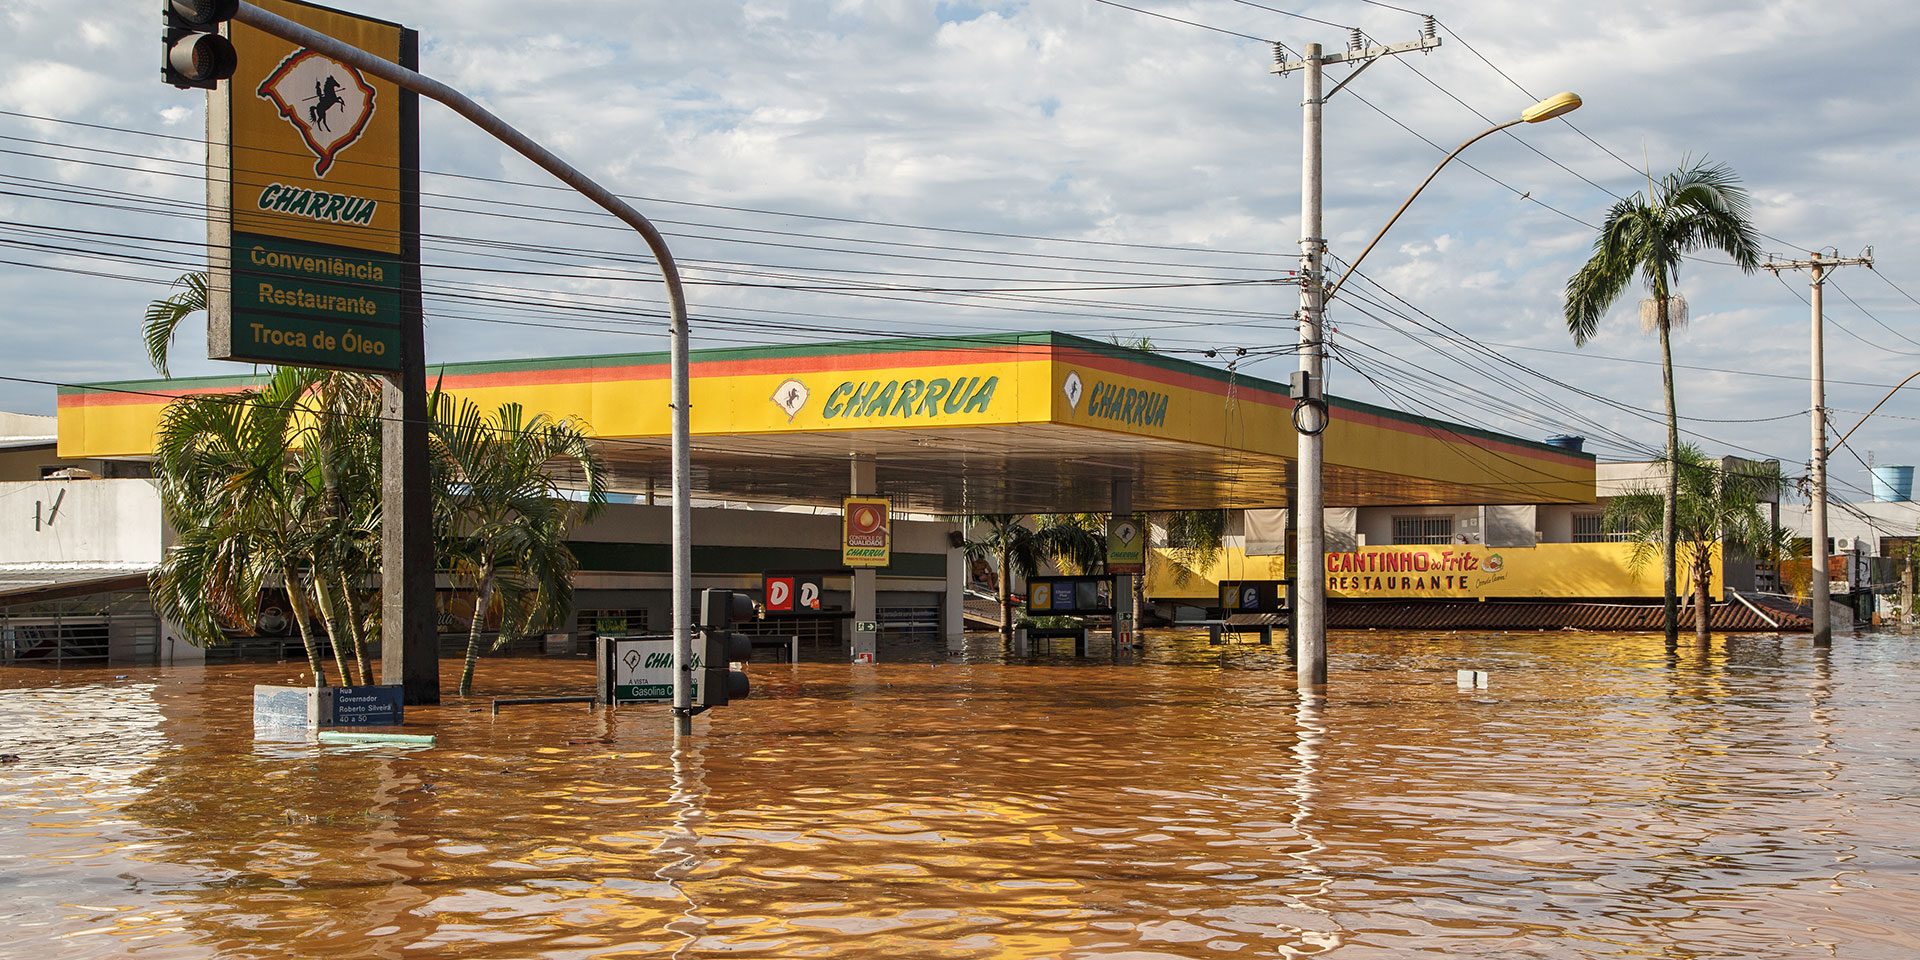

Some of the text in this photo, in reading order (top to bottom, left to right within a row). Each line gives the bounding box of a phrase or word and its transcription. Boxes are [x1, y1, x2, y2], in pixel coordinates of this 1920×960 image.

[258, 183, 377, 226] CHARRUA
[251, 246, 384, 282] Conveniência
[259, 283, 377, 315] Restaurante
[250, 323, 385, 356] Troca de Óleo
[822, 376, 999, 419] CHARRUA
[1088, 381, 1169, 427] CHARRUA
[846, 549, 886, 557] CHARRUA
[1327, 551, 1480, 573] CANTINHO do Fritz
[770, 581, 789, 605] D
[1033, 586, 1048, 605] G
[1329, 575, 1469, 590] RESTAURANTE
[632, 685, 665, 696] Gasolina
